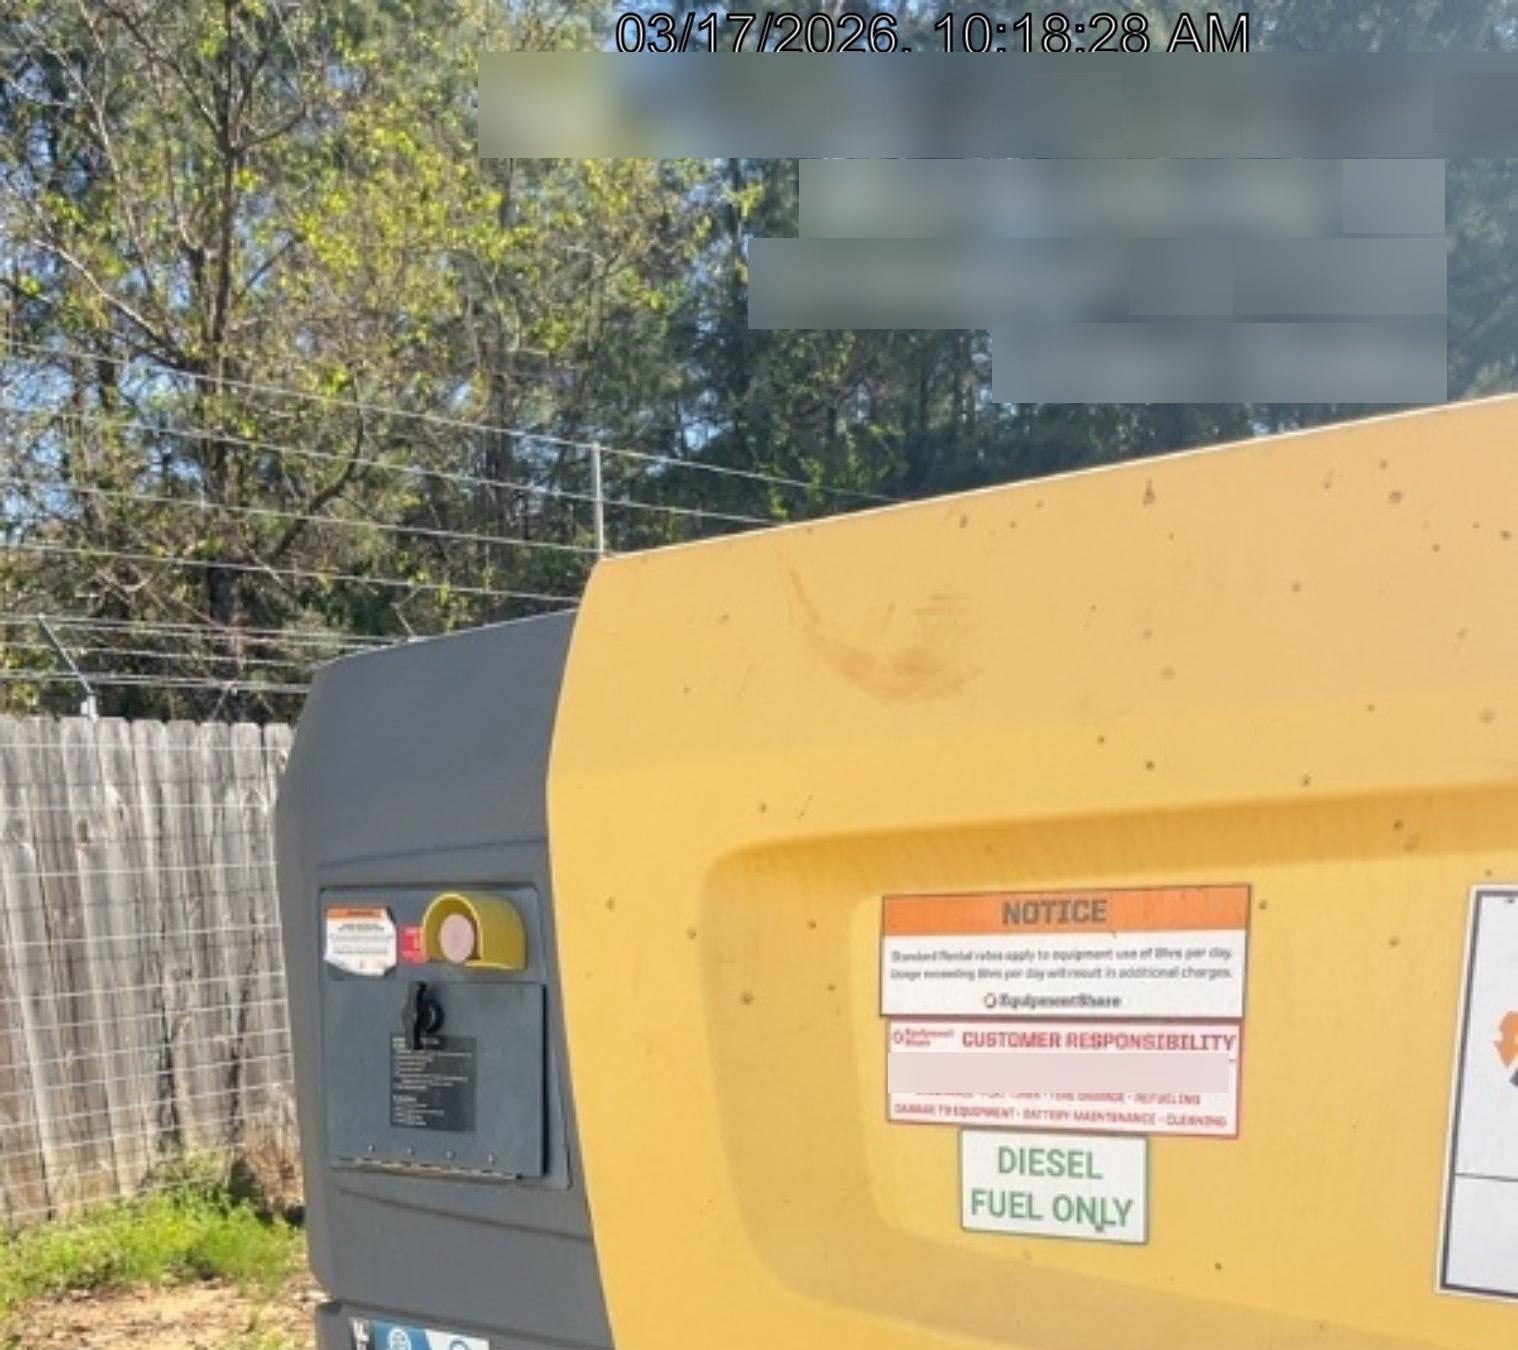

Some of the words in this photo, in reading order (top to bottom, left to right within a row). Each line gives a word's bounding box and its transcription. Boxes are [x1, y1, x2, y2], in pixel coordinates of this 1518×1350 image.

[1002, 899, 1107, 925] NOTICE
[938, 950, 972, 961] Rental
[974, 950, 1002, 960] rates
[1005, 949, 1035, 963] apply
[1037, 949, 1050, 960] to
[1052, 948, 1113, 962] equipment
[1115, 949, 1137, 959] use
[1139, 948, 1152, 958] of
[1184, 948, 1206, 961] per
[890, 968, 921, 982] Usage
[923, 968, 975, 982] exceeding
[1004, 969, 1023, 981] per
[1025, 968, 1045, 981] day
[1046, 967, 1066, 979] will
[1067, 967, 1102, 979] result
[1105, 966, 1116, 978] in
[1118, 966, 1179, 979] additional
[1181, 965, 1232, 981] charges.
[999, 992, 1122, 1009] EquipmentShare
[962, 1031, 1061, 1048] CUSTOMER
[1065, 1031, 1236, 1051] RESPONSIBILITY
[1134, 1093, 1201, 1105] REFUELING
[894, 1103, 936, 1114] DAMAGE
[953, 1104, 1015, 1118] EQUIPMENT
[1022, 1108, 1070, 1120] BATTERY
[1074, 1110, 1156, 1125] MAINTENANCE
[998, 1146, 1104, 1180] DIESEL
[971, 1188, 1043, 1221] FUEL
[1052, 1193, 1134, 1228] ONLY
